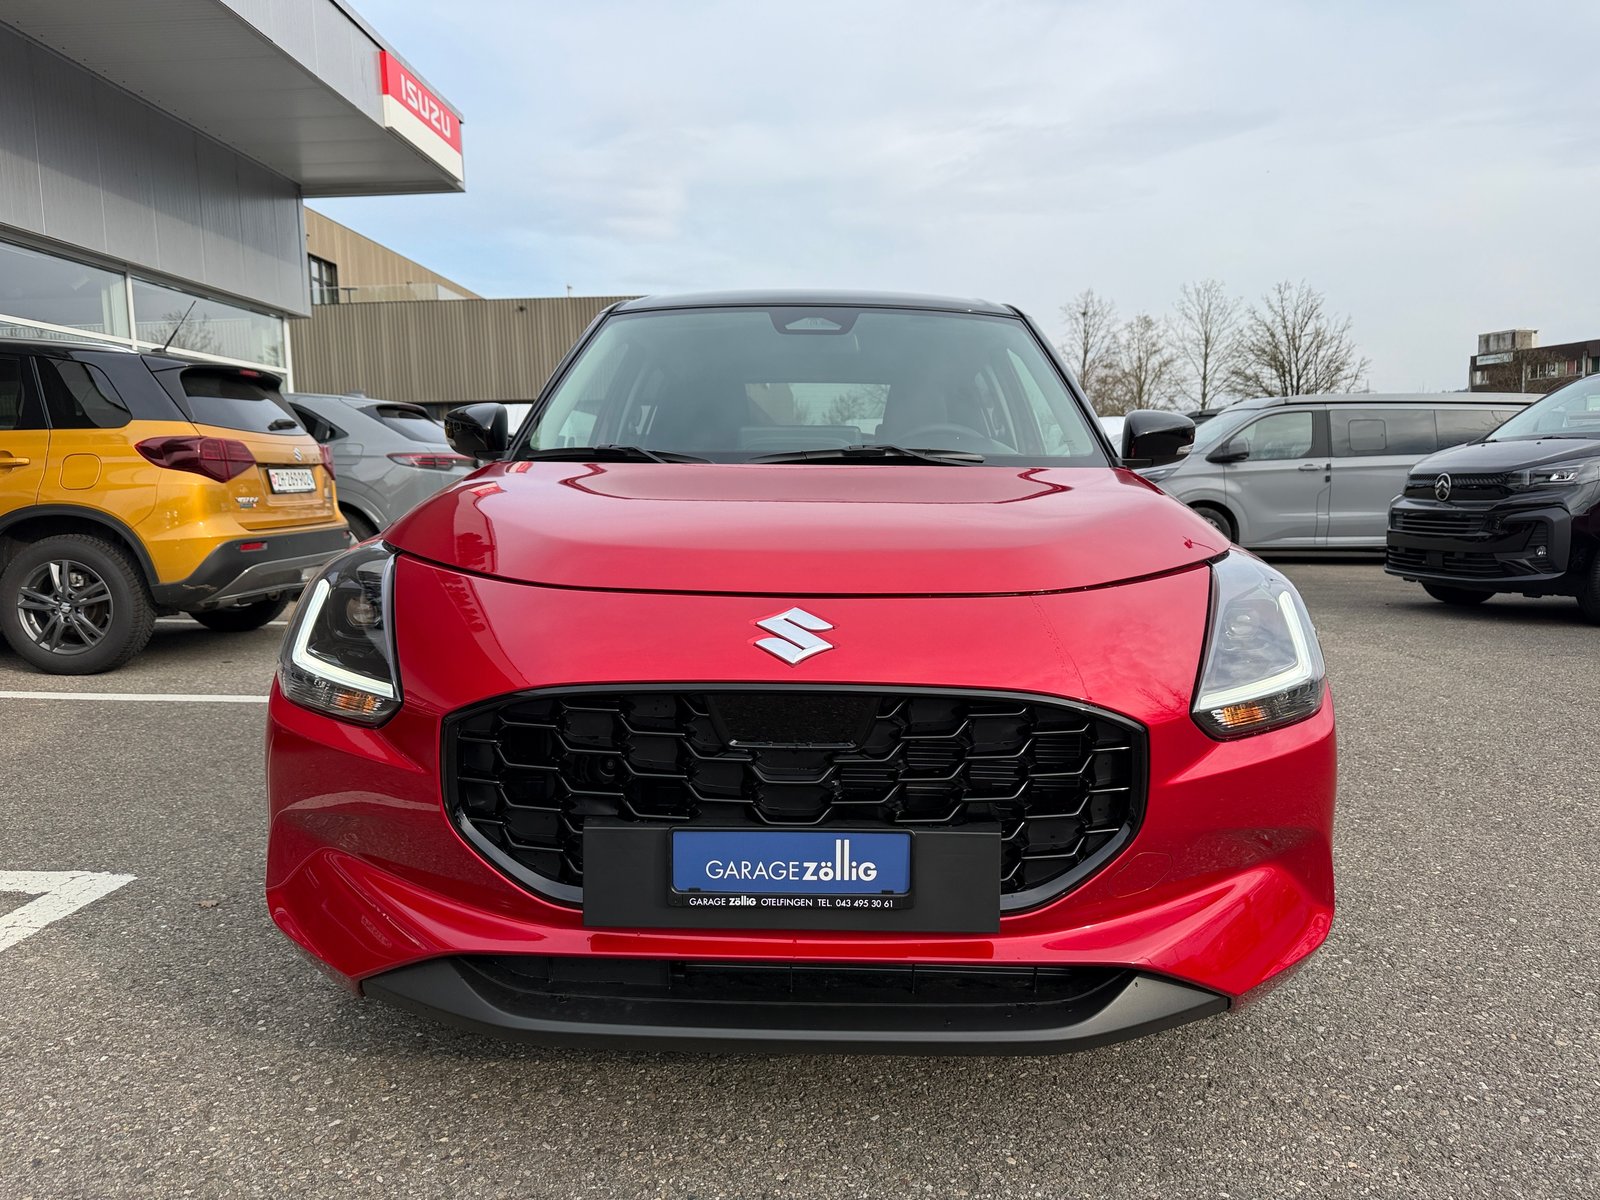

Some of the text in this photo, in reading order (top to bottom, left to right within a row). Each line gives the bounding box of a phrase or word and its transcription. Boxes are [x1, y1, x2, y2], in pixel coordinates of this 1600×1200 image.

[400, 73, 451, 138] ISUZU
[705, 859, 800, 881] GARAGE
[688, 897, 726, 906] GARAGE
[760, 898, 812, 907] OTELFINGEN
[817, 898, 833, 907] TEL.
[835, 898, 852, 908] 043
[853, 898, 869, 908] 495
[870, 898, 882, 908] 30
[883, 898, 894, 908] 61
